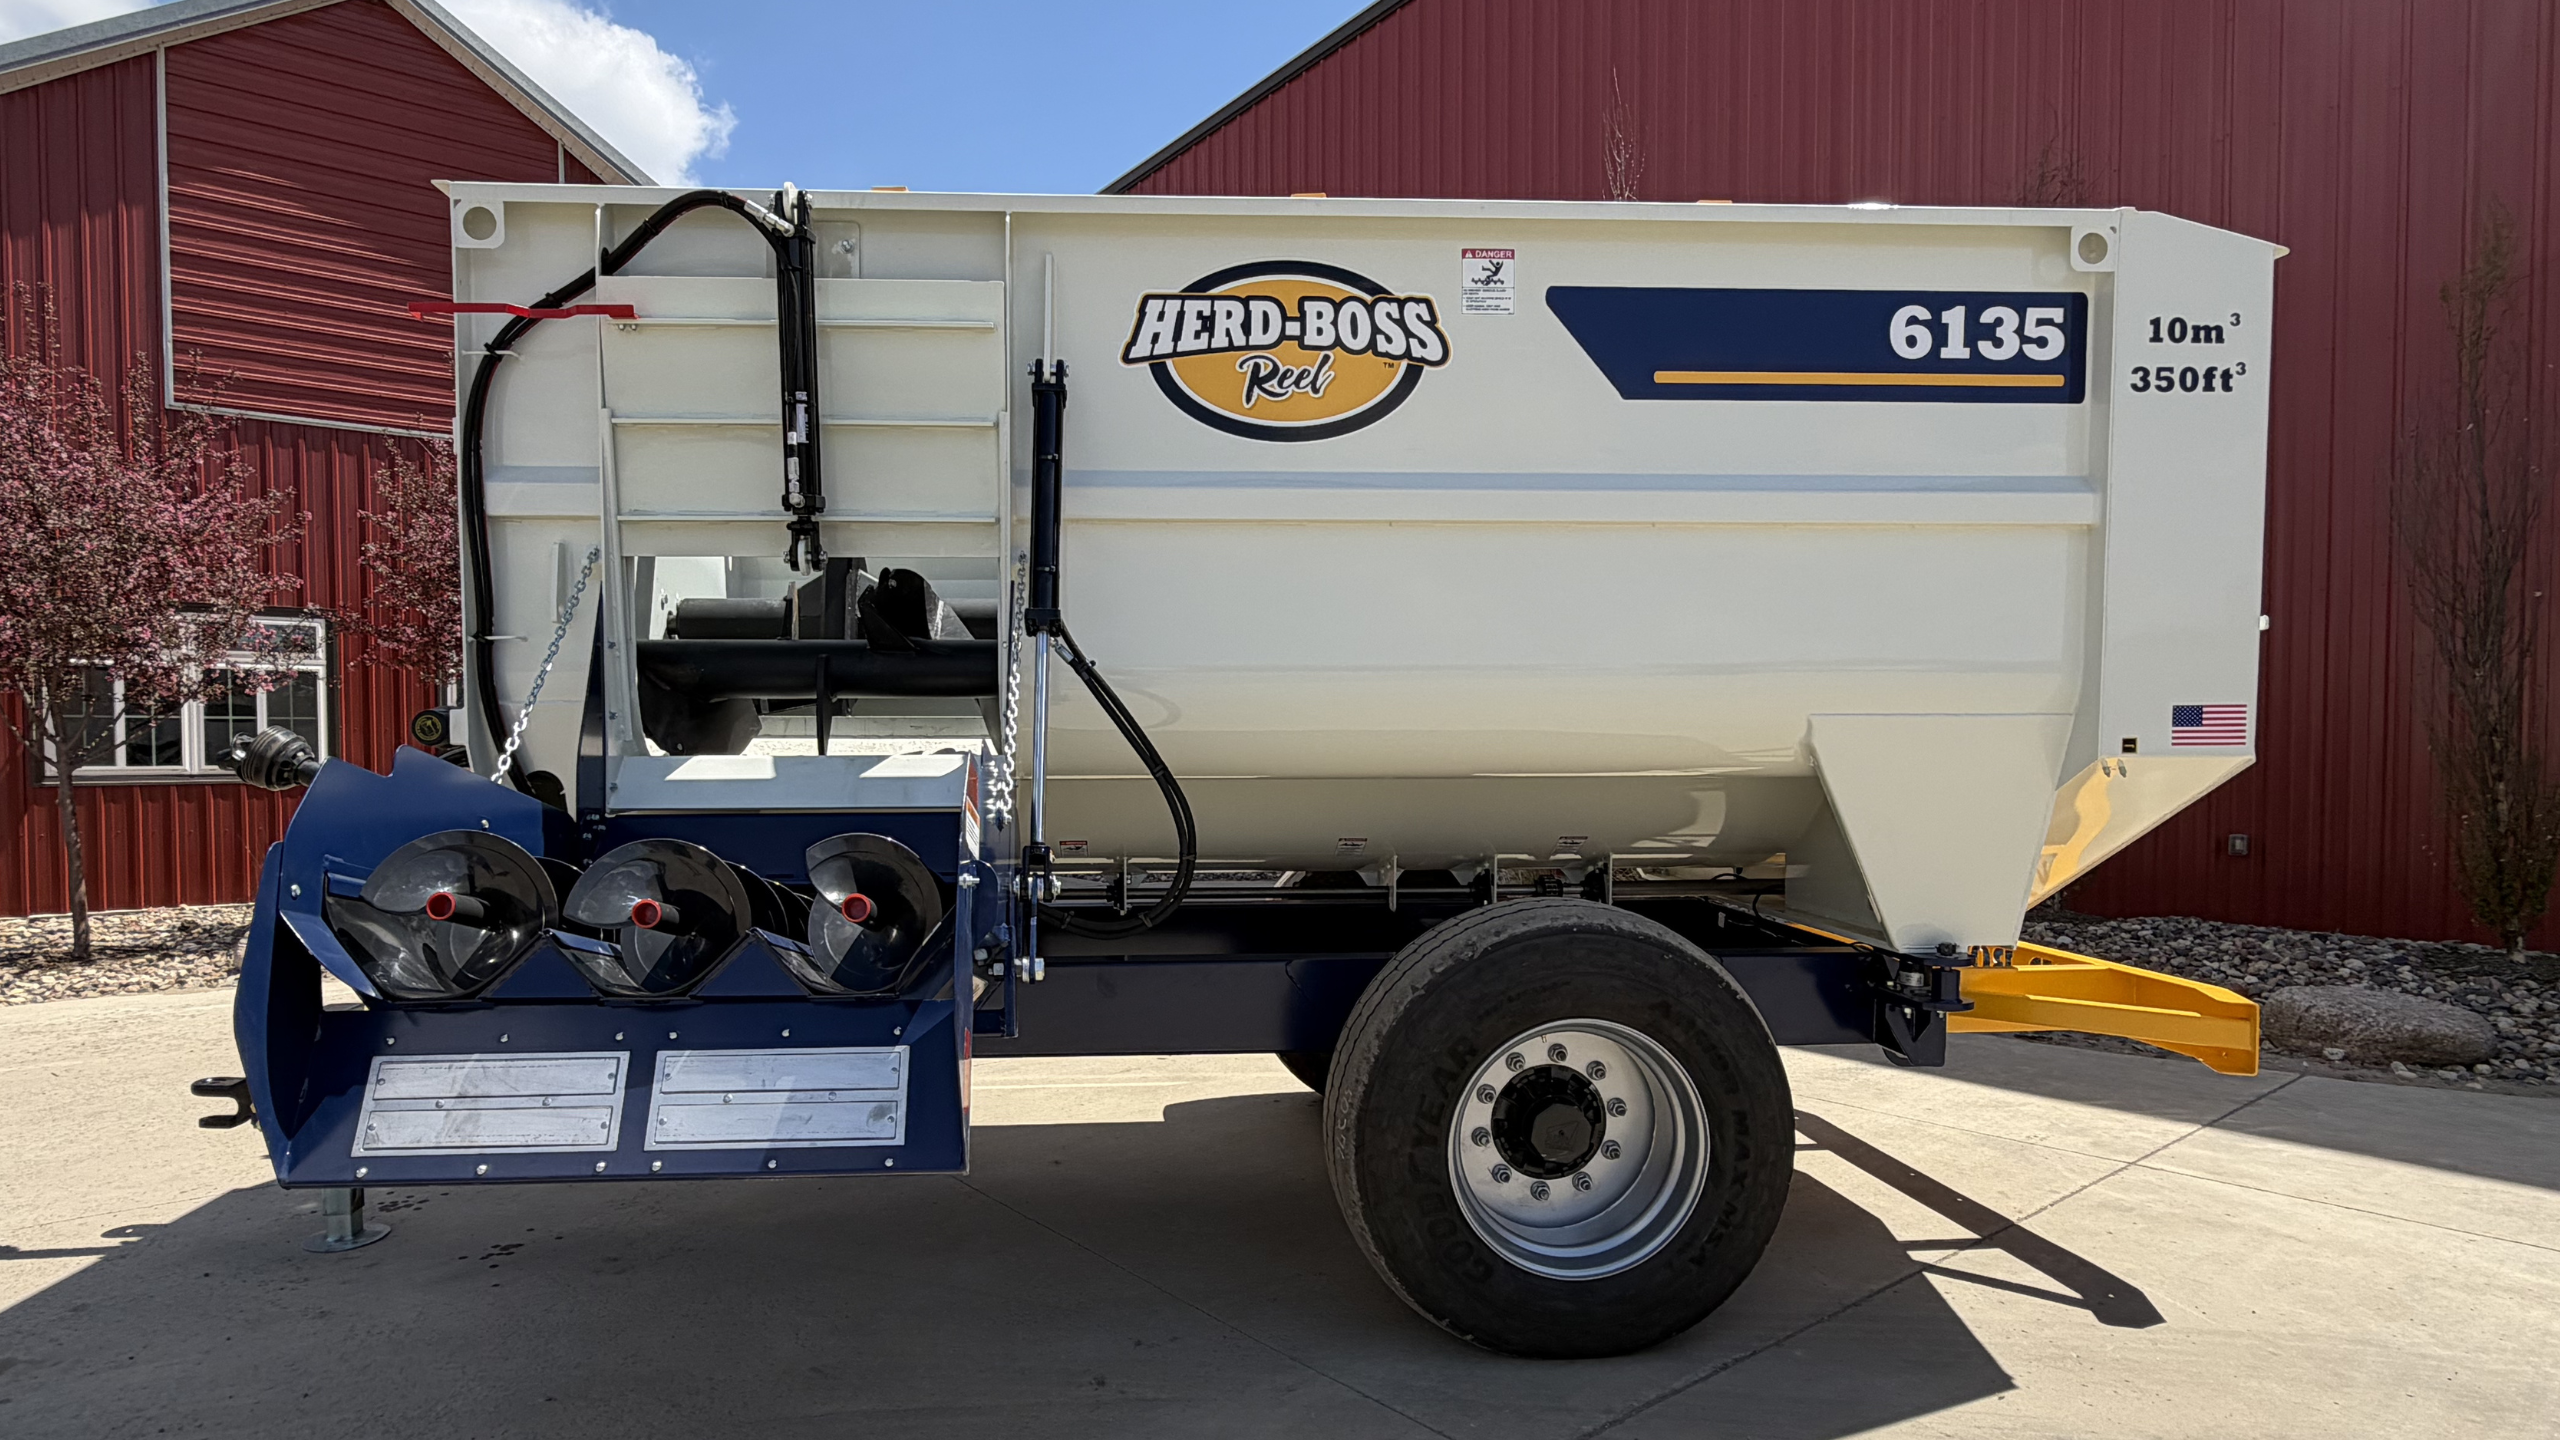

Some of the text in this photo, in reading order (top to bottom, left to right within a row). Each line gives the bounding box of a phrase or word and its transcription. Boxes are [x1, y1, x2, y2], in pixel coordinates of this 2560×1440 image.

[1475, 250, 1512, 258] DANGER
[1129, 299, 1443, 362] HERD-BOSS
[1889, 305, 2065, 360] 6135
[1238, 353, 1332, 406] Reel
[1408, 1036, 1494, 1284] GOODYEAR
